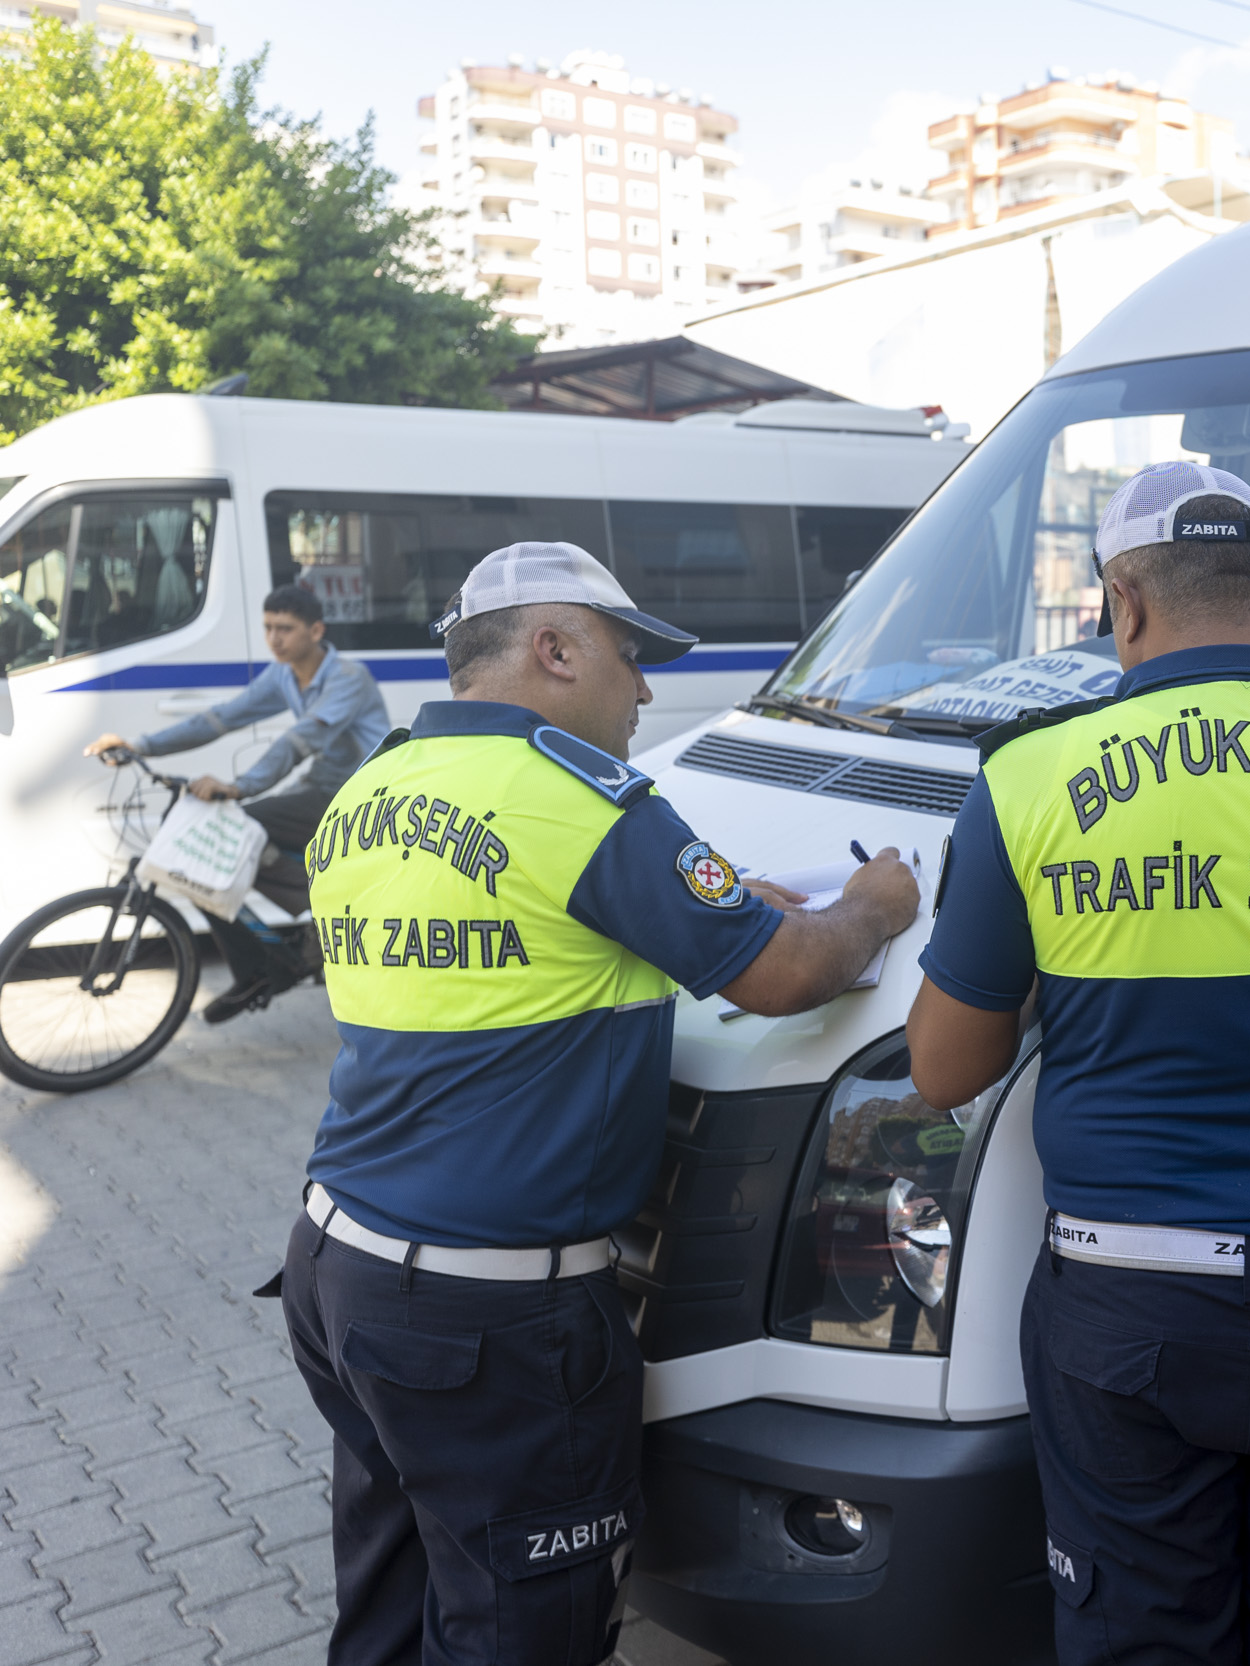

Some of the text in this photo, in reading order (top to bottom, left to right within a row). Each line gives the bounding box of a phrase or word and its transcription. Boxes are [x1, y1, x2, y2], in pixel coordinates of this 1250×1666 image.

[1181, 524, 1238, 536] ZABITA
[434, 610, 458, 633] ZABITA
[683, 845, 704, 864] ZABITA
[1041, 840, 1222, 915] TRAFİK
[314, 905, 531, 969] AFİK ZABITA
[1051, 1222, 1098, 1244] ZABITA
[527, 1510, 627, 1560] ZABITA
